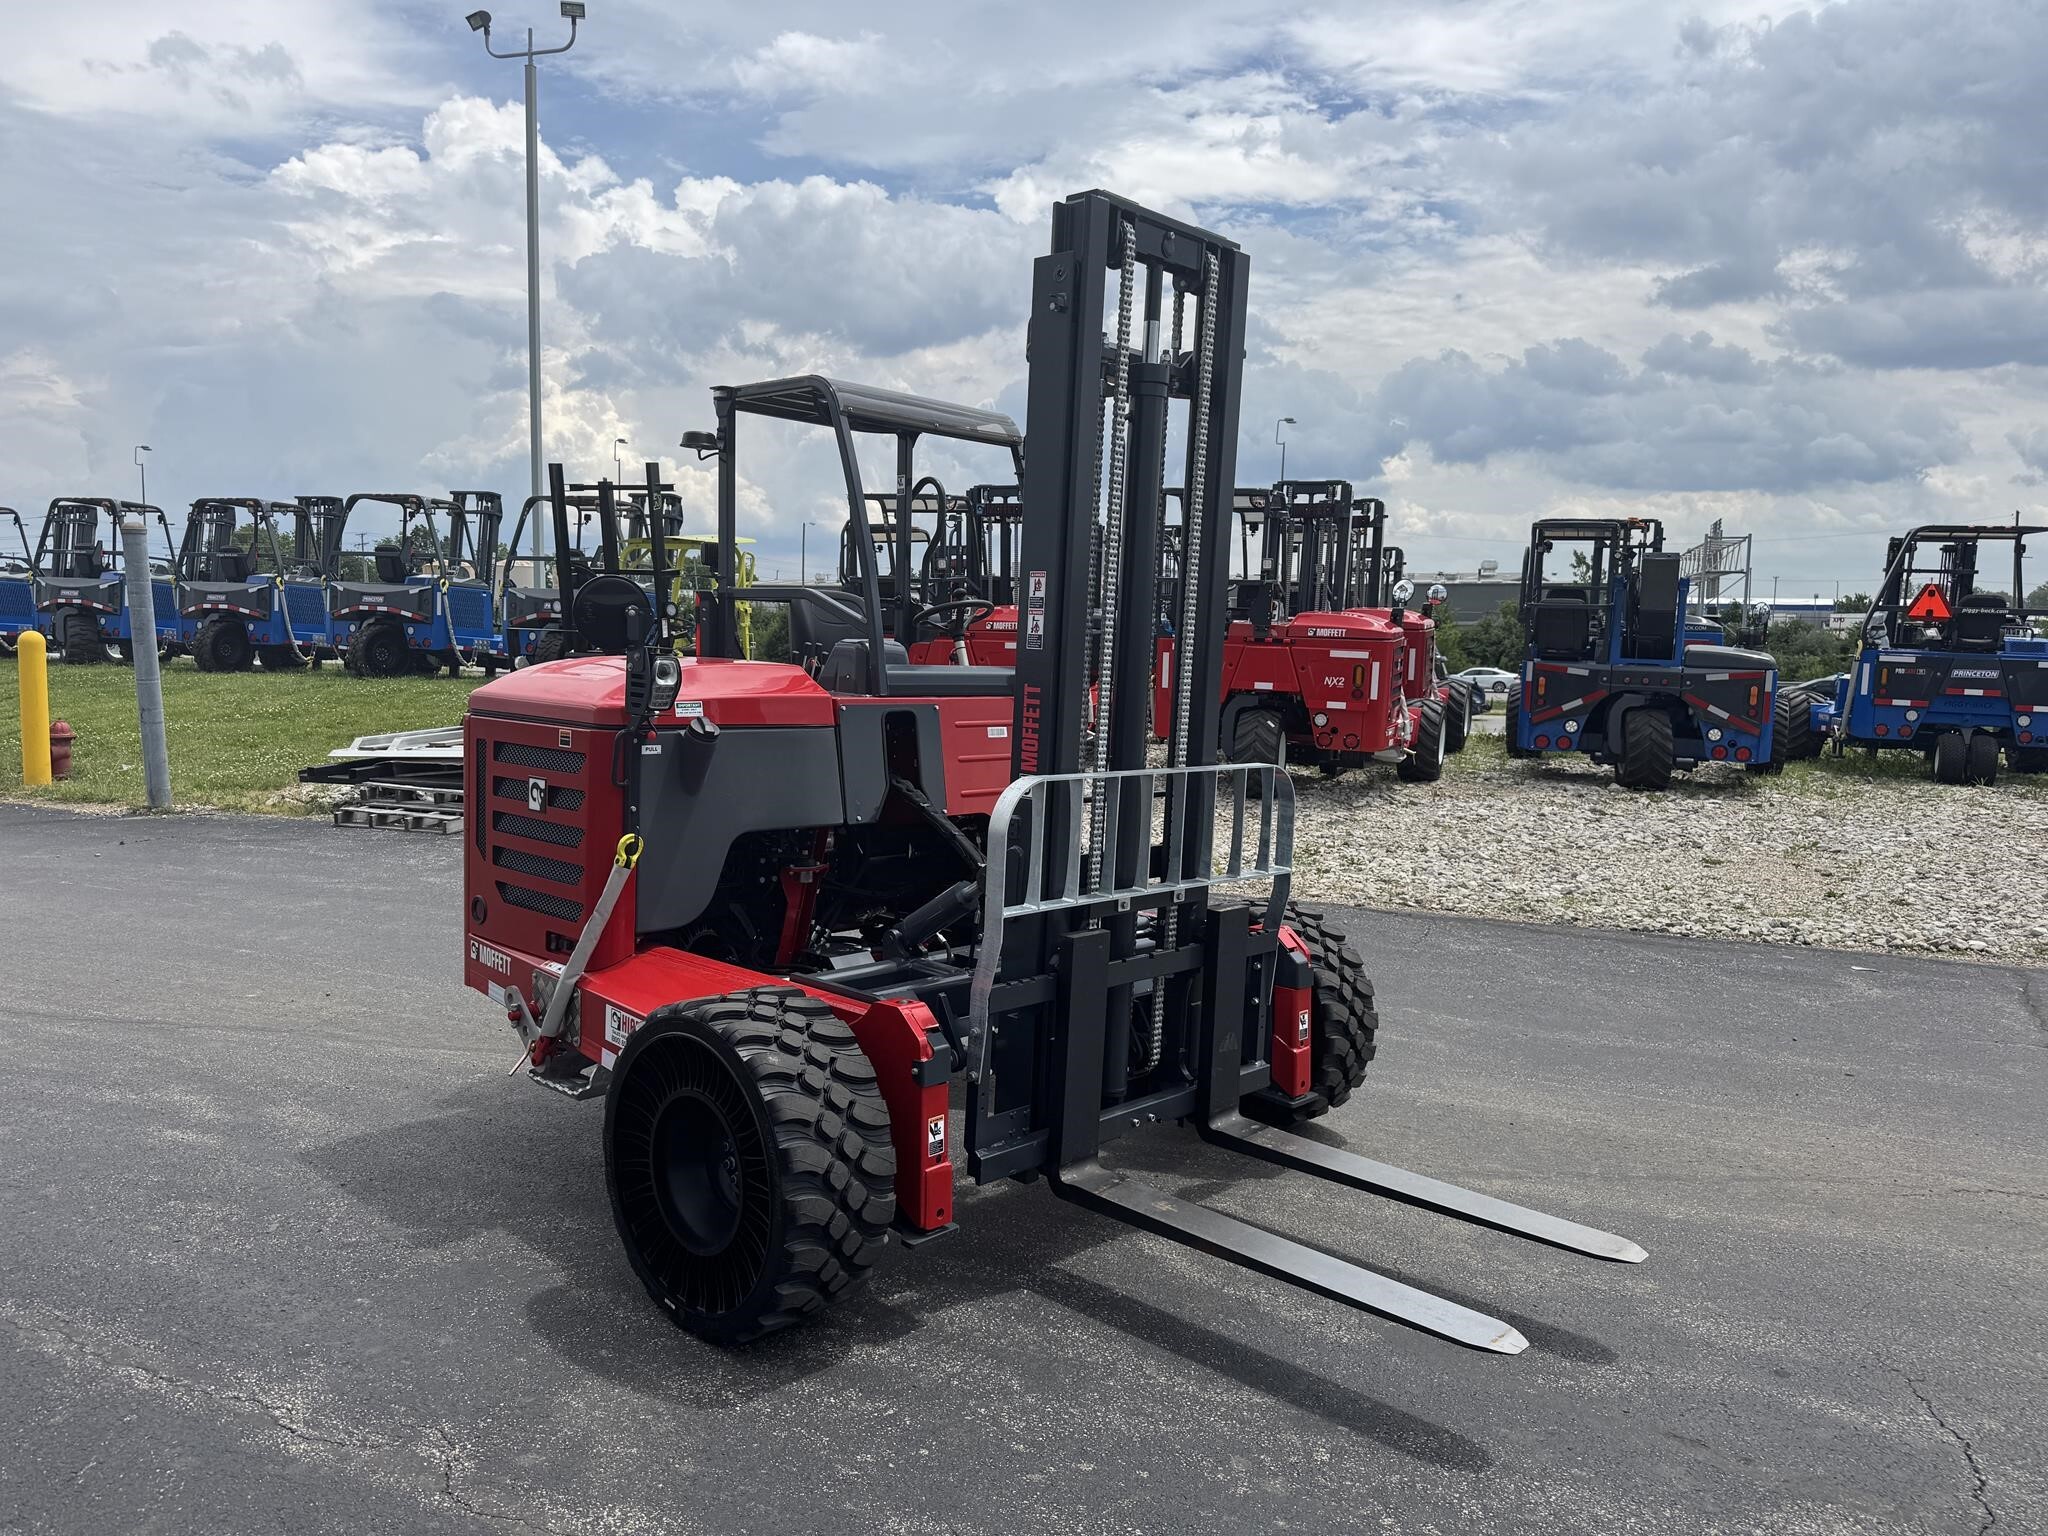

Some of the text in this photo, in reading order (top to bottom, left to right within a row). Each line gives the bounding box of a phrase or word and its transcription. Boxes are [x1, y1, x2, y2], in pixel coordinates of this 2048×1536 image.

[993, 621, 1018, 630] MOFFETT
[1316, 628, 1347, 637] MOFFETT
[1952, 669, 1998, 679] PRINCETON
[1324, 676, 1345, 688] NX2
[1021, 683, 1041, 773] MOFFETT
[479, 943, 512, 977] MOFFETT
[622, 1014, 642, 1034] HIA
